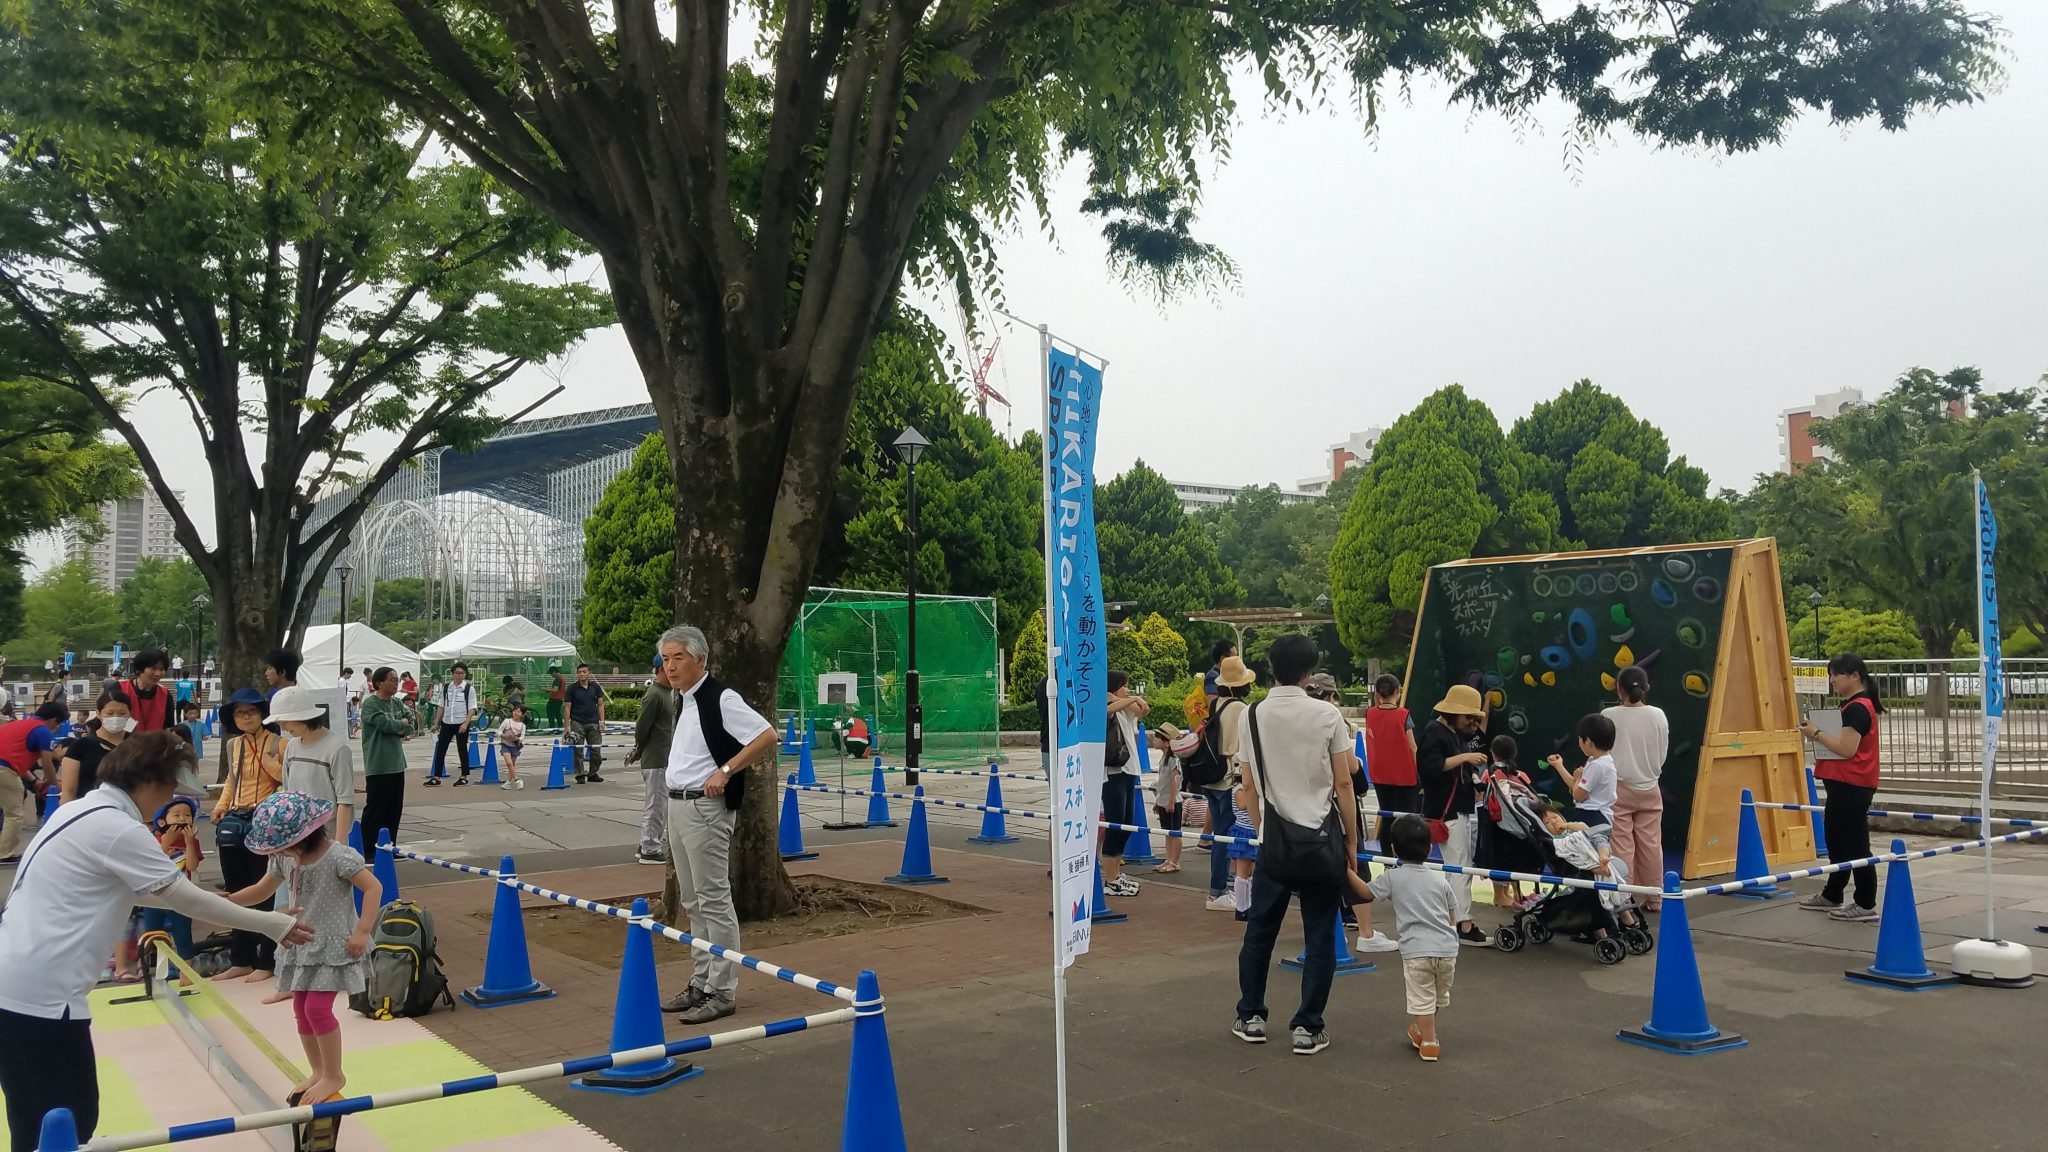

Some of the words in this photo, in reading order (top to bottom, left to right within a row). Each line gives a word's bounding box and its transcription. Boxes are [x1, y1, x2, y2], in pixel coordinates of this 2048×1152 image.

[1446, 579, 1499, 602] 光が丘
[1451, 599, 1498, 621] スポーツ
[1456, 618, 1493, 638] フェスタ
